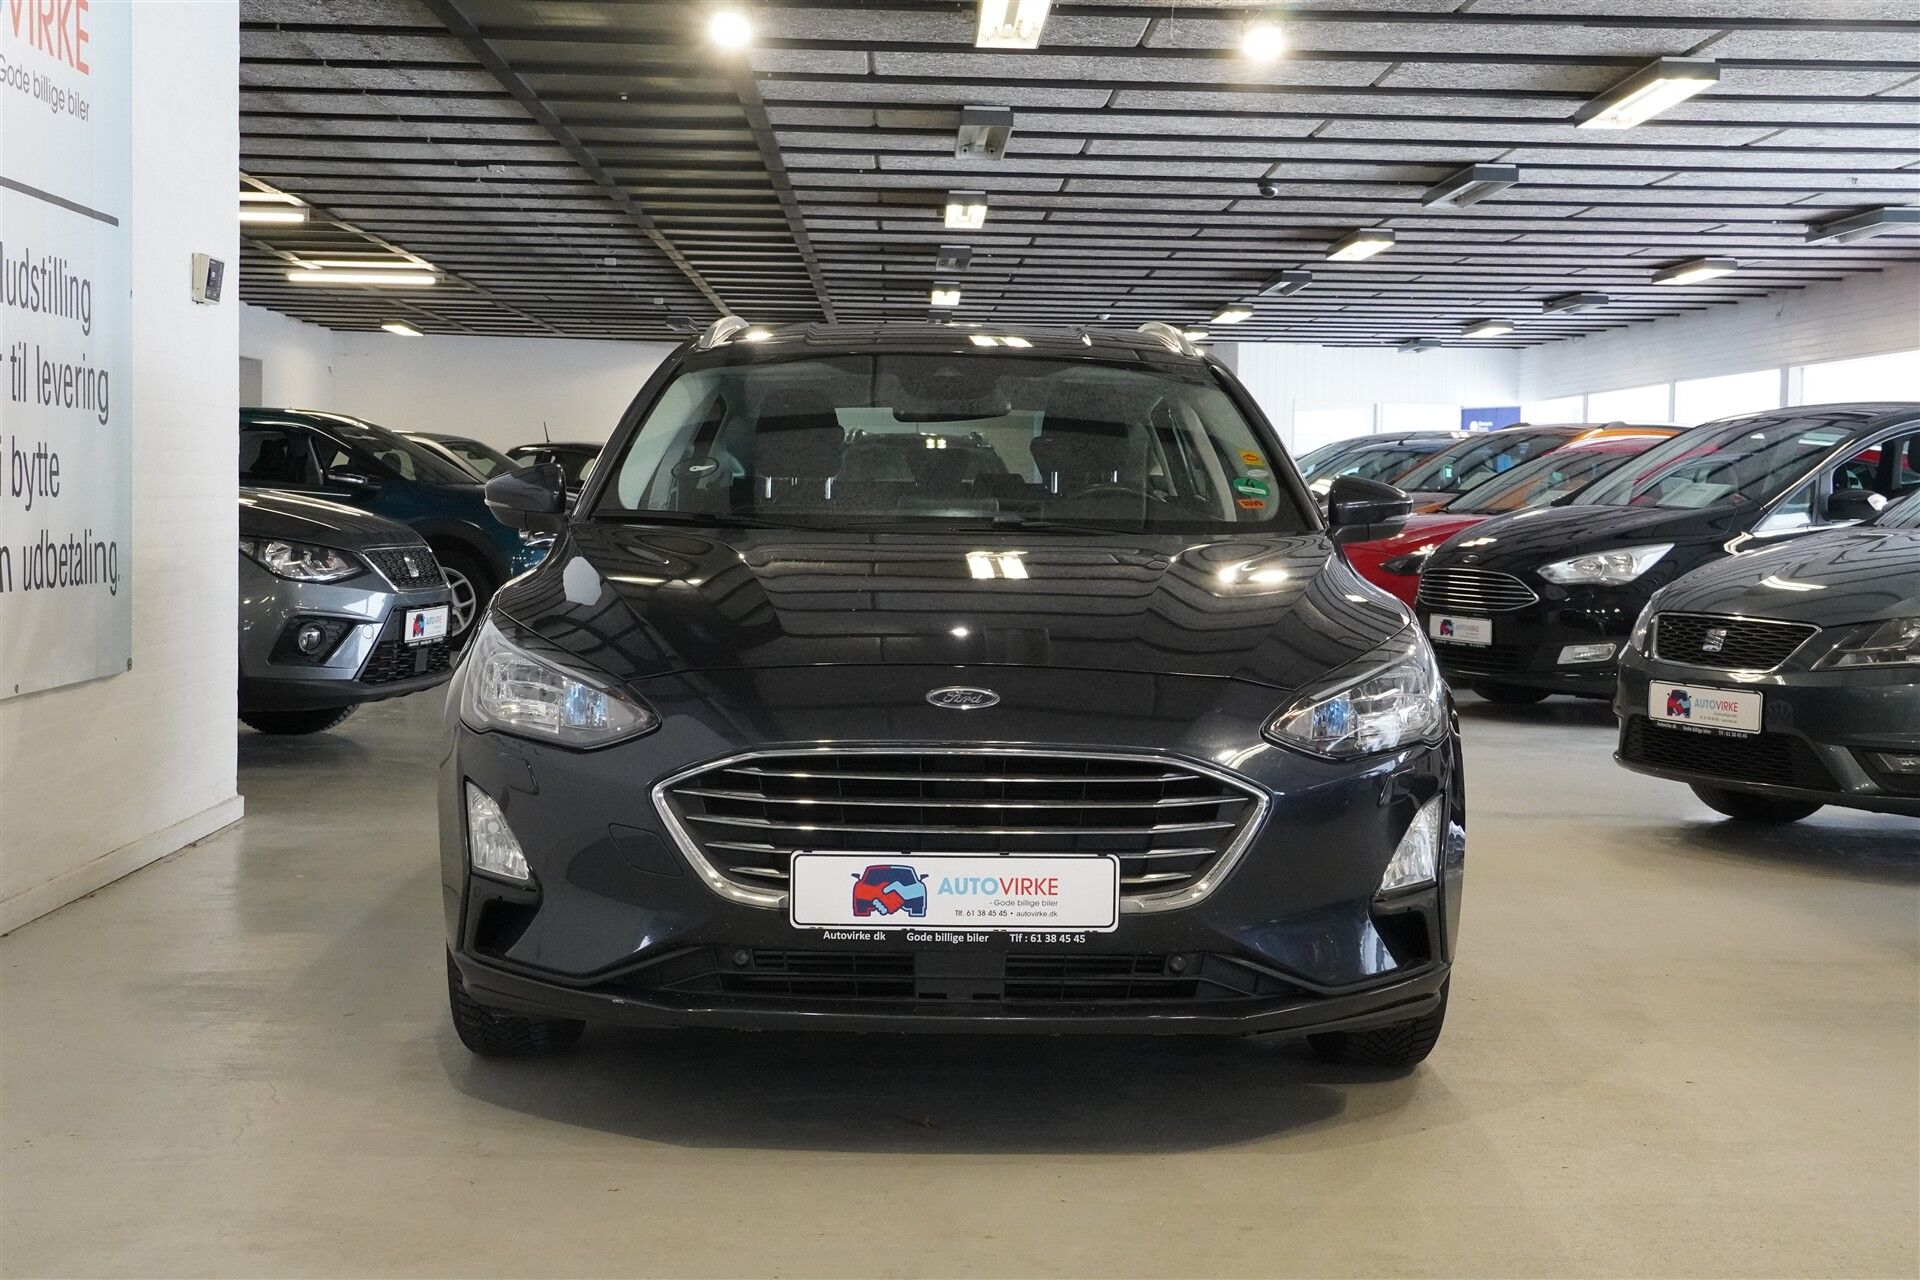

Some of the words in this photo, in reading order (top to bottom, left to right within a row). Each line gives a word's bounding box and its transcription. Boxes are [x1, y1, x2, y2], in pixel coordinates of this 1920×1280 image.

[33, 70, 65, 114] billige
[68, 87, 89, 122] biler
[10, 341, 27, 402] til
[36, 345, 109, 426] levering
[12, 435, 60, 511] bytte
[23, 529, 120, 596] udbetaling.
[943, 690, 983, 703] Ford
[1694, 699, 1738, 712] AUTOVIRKE
[937, 877, 1059, 895] AUTOVIRKE
[993, 899, 1016, 907] Gode
[1017, 899, 1040, 909] billige
[1041, 899, 1058, 907] biler
[966, 909, 975, 917] 61
[977, 909, 986, 917] 38
[987, 909, 997, 917] 45
[998, 909, 1008, 917] 45
[823, 931, 871, 940] Autovirke
[873, 931, 886, 941] dk
[906, 932, 933, 942] Gode
[935, 932, 965, 944] billige
[966, 933, 990, 943] biler
[1030, 934, 1042, 943] 61
[1045, 934, 1057, 943] 38
[1059, 934, 1071, 943] 45
[1073, 934, 1086, 943] 45
